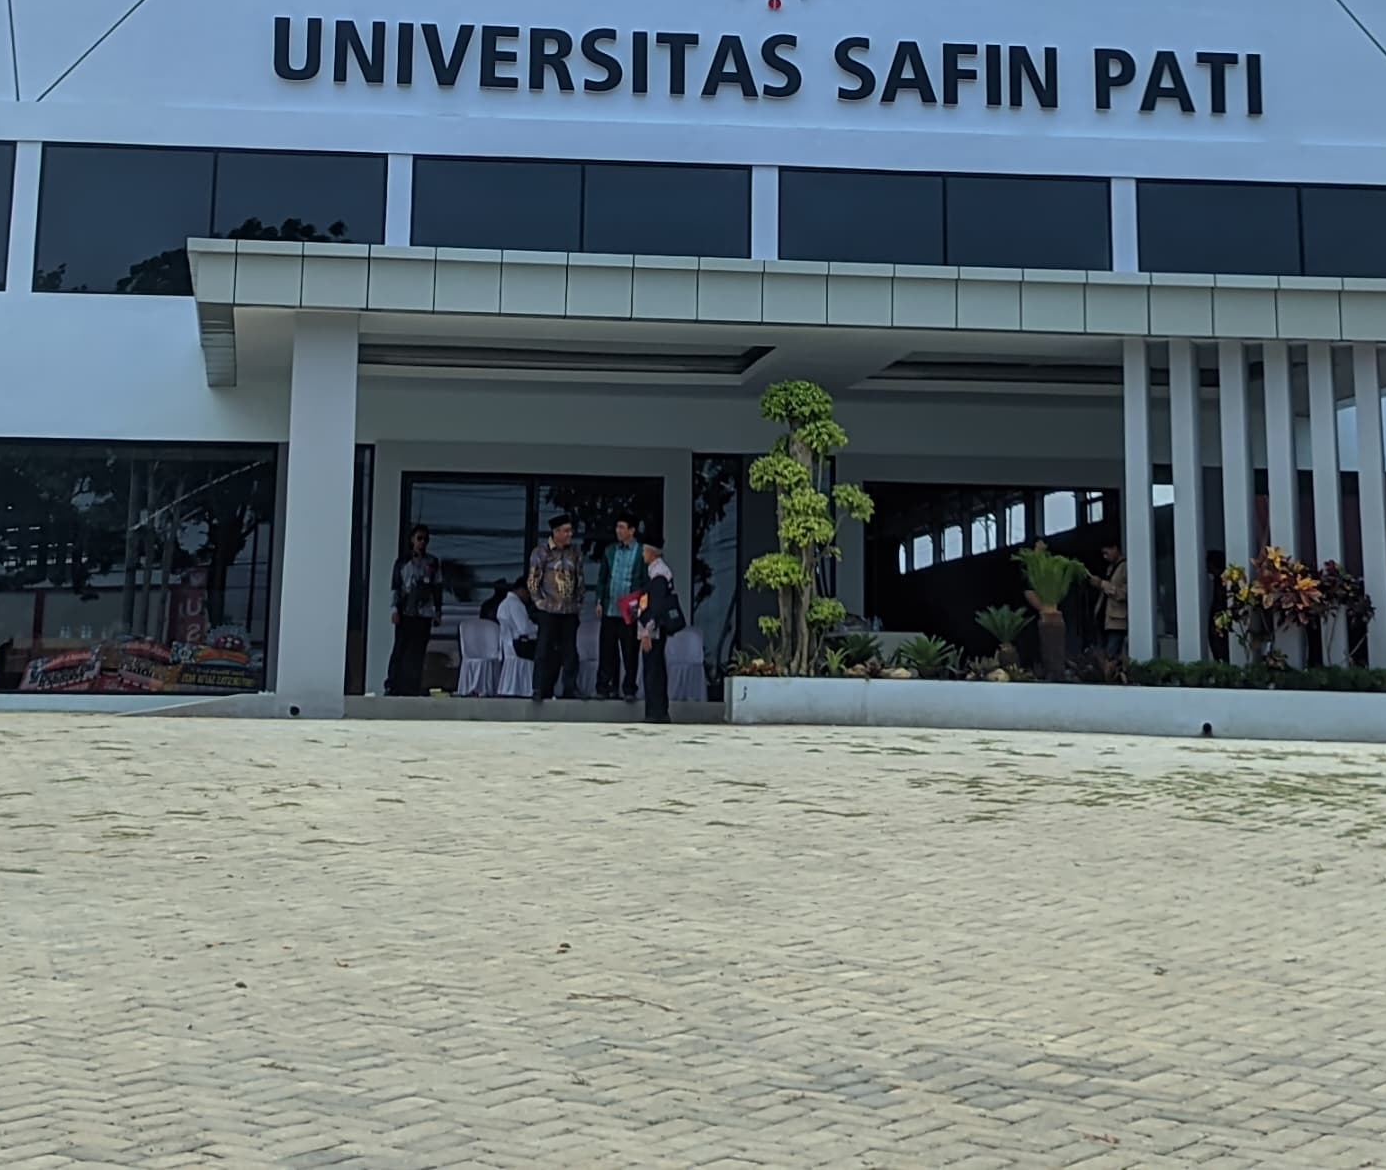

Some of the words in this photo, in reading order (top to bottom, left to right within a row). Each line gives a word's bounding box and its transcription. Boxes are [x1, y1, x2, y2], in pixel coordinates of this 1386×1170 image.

[273, 16, 803, 98] UNIVERSITAS
[833, 36, 1059, 109] SAFIN
[1094, 47, 1263, 115] PATI
